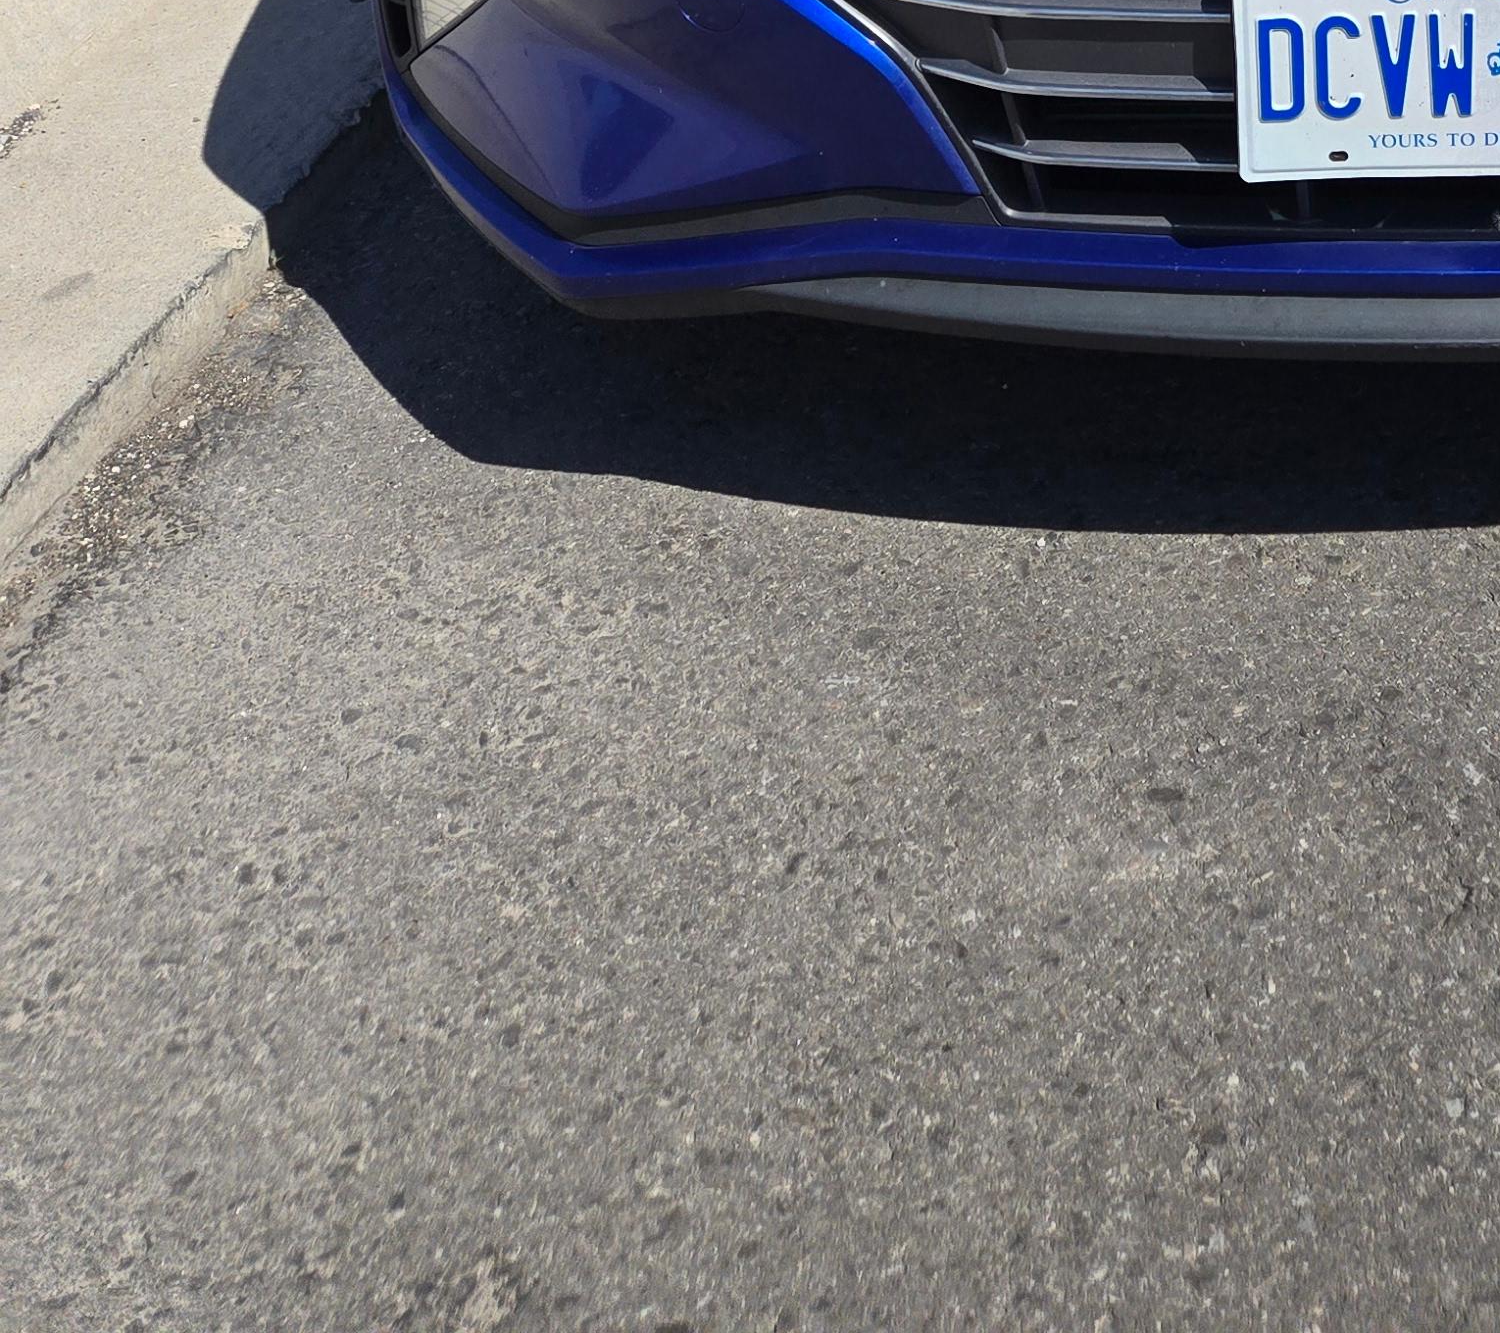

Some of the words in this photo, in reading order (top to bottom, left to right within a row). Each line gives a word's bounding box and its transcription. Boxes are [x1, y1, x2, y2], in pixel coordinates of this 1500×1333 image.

[1257, 13, 1476, 122] DCVW
[1368, 133, 1438, 149] YOURS
[1447, 133, 1475, 148] TO
